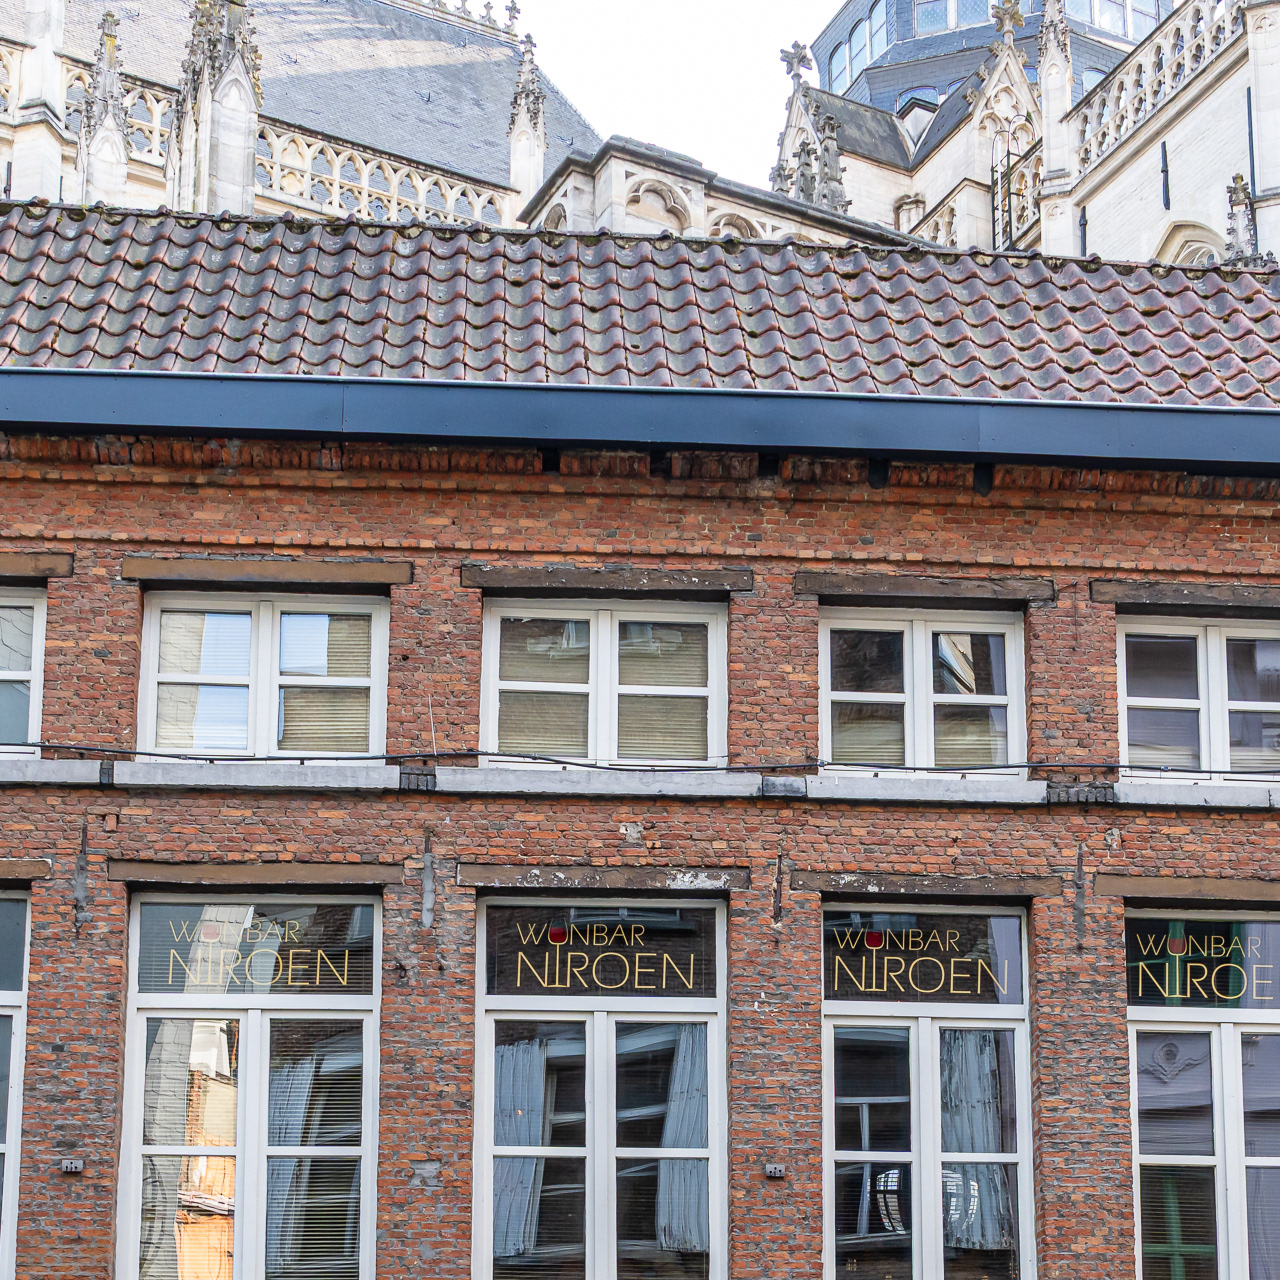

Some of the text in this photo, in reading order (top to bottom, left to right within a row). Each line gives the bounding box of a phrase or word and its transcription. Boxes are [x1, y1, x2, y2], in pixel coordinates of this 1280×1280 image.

[168, 948, 349, 985] NIROEN
[517, 951, 694, 988] NIROEN
[834, 955, 1008, 994] NIROEN
